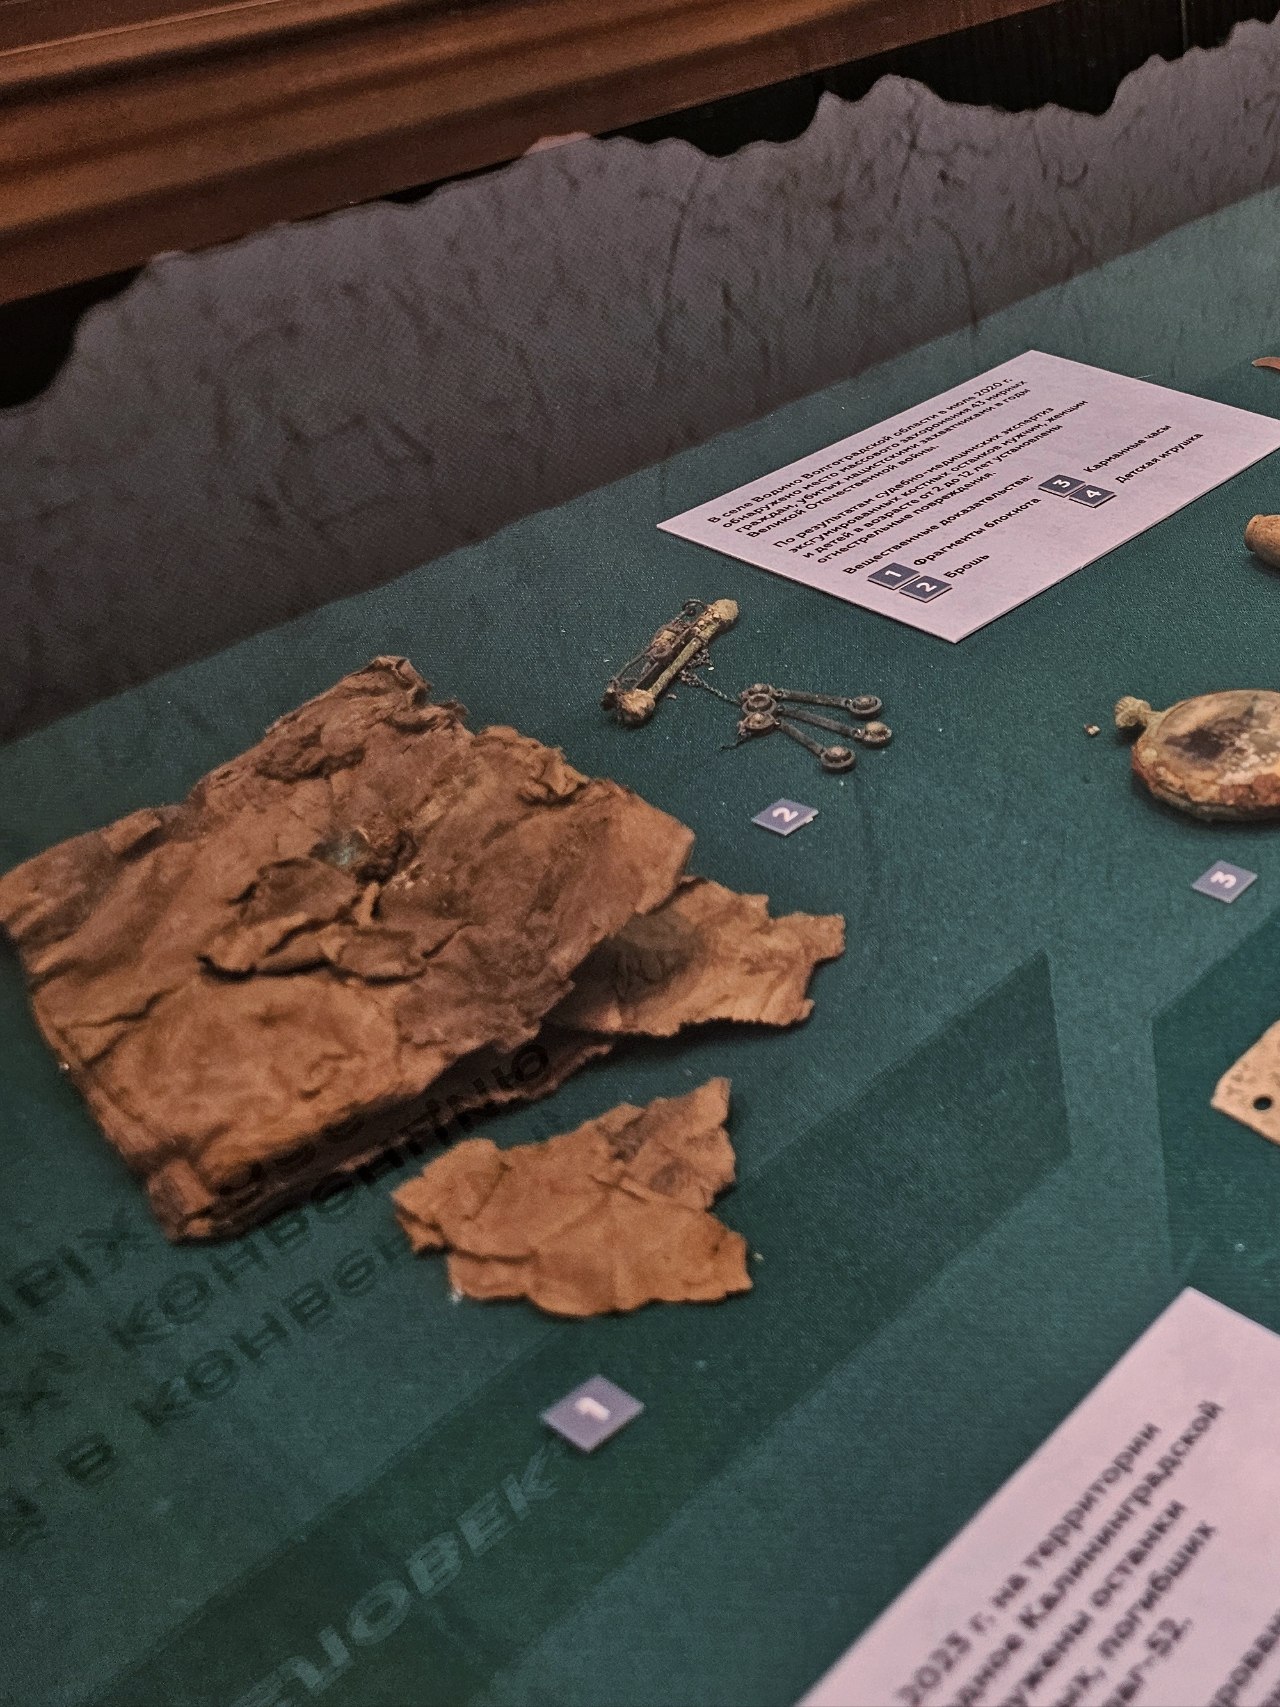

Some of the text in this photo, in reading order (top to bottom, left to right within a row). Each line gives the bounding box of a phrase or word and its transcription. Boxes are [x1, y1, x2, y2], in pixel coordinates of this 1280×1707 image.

[721, 502, 754, 518] селе
[750, 479, 803, 503] Водино
[800, 435, 894, 480] Волгоградской
[893, 414, 940, 437] области
[945, 396, 977, 411] июле
[973, 382, 1003, 397] 2020
[722, 489, 803, 528] обнаружено
[801, 472, 839, 491] место
[838, 442, 901, 473] массового
[899, 407, 972, 444] захоронения
[985, 380, 1027, 402] мирных
[735, 503, 799, 533] граждан,
[796, 480, 845, 505] убитых
[843, 443, 921, 481] нацистскими
[919, 406, 996, 444] захватчиками
[1002, 388, 1031, 403] годы
[746, 445, 940, 538] Великой Отечественной войны.
[789, 400, 1089, 553] эксгумированных костных останков мужчин, женщин
[795, 498, 876, 539] результатам
[875, 434, 1003, 499] судебно-медицинских
[1000, 407, 1054, 435] экспертиз
[814, 531, 855, 554] детей
[863, 499, 920, 528] возрасте
[973, 460, 994, 473] лет
[992, 424, 1063, 462] установлены
[1052, 425, 1172, 488] 3 Карманные часы
[1086, 433, 1203, 498] 4 Детская игрушка
[817, 472, 996, 564] огнестрельные повреждения.
[842, 475, 1034, 575] Вещественные доказательства:
[884, 498, 1042, 578] 1 Фрагменты блокнота
[916, 555, 990, 592] 2 Брошь
[772, 806, 798, 822] 2
[1209, 868, 1237, 890] 3
[574, 1395, 612, 1422] 1
[989, 1573, 1031, 1611] на
[1022, 1423, 1160, 1571] территории
[1016, 1401, 1223, 1632] Калининградской
[1089, 1500, 1187, 1611] останки
[1096, 1521, 1218, 1662] погибших
